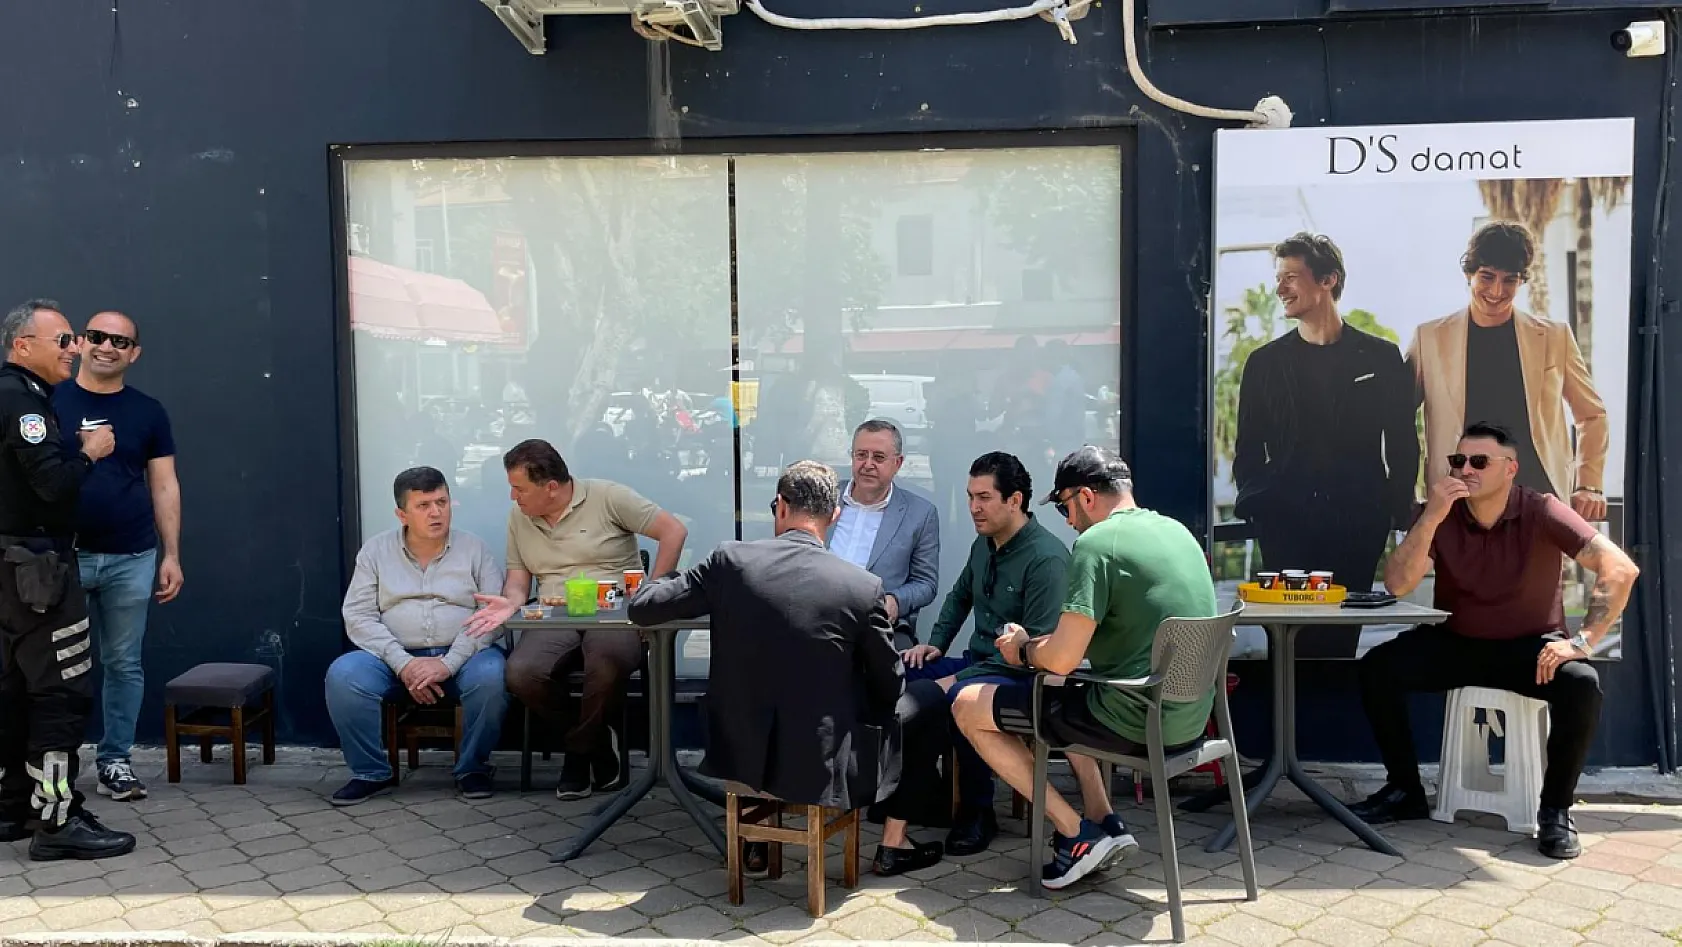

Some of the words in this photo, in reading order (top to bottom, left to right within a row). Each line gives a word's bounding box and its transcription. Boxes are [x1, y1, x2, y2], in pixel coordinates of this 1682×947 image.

[1326, 134, 1398, 175] D'S
[1410, 144, 1523, 172] damat
[1283, 593, 1314, 602] TUBORG
